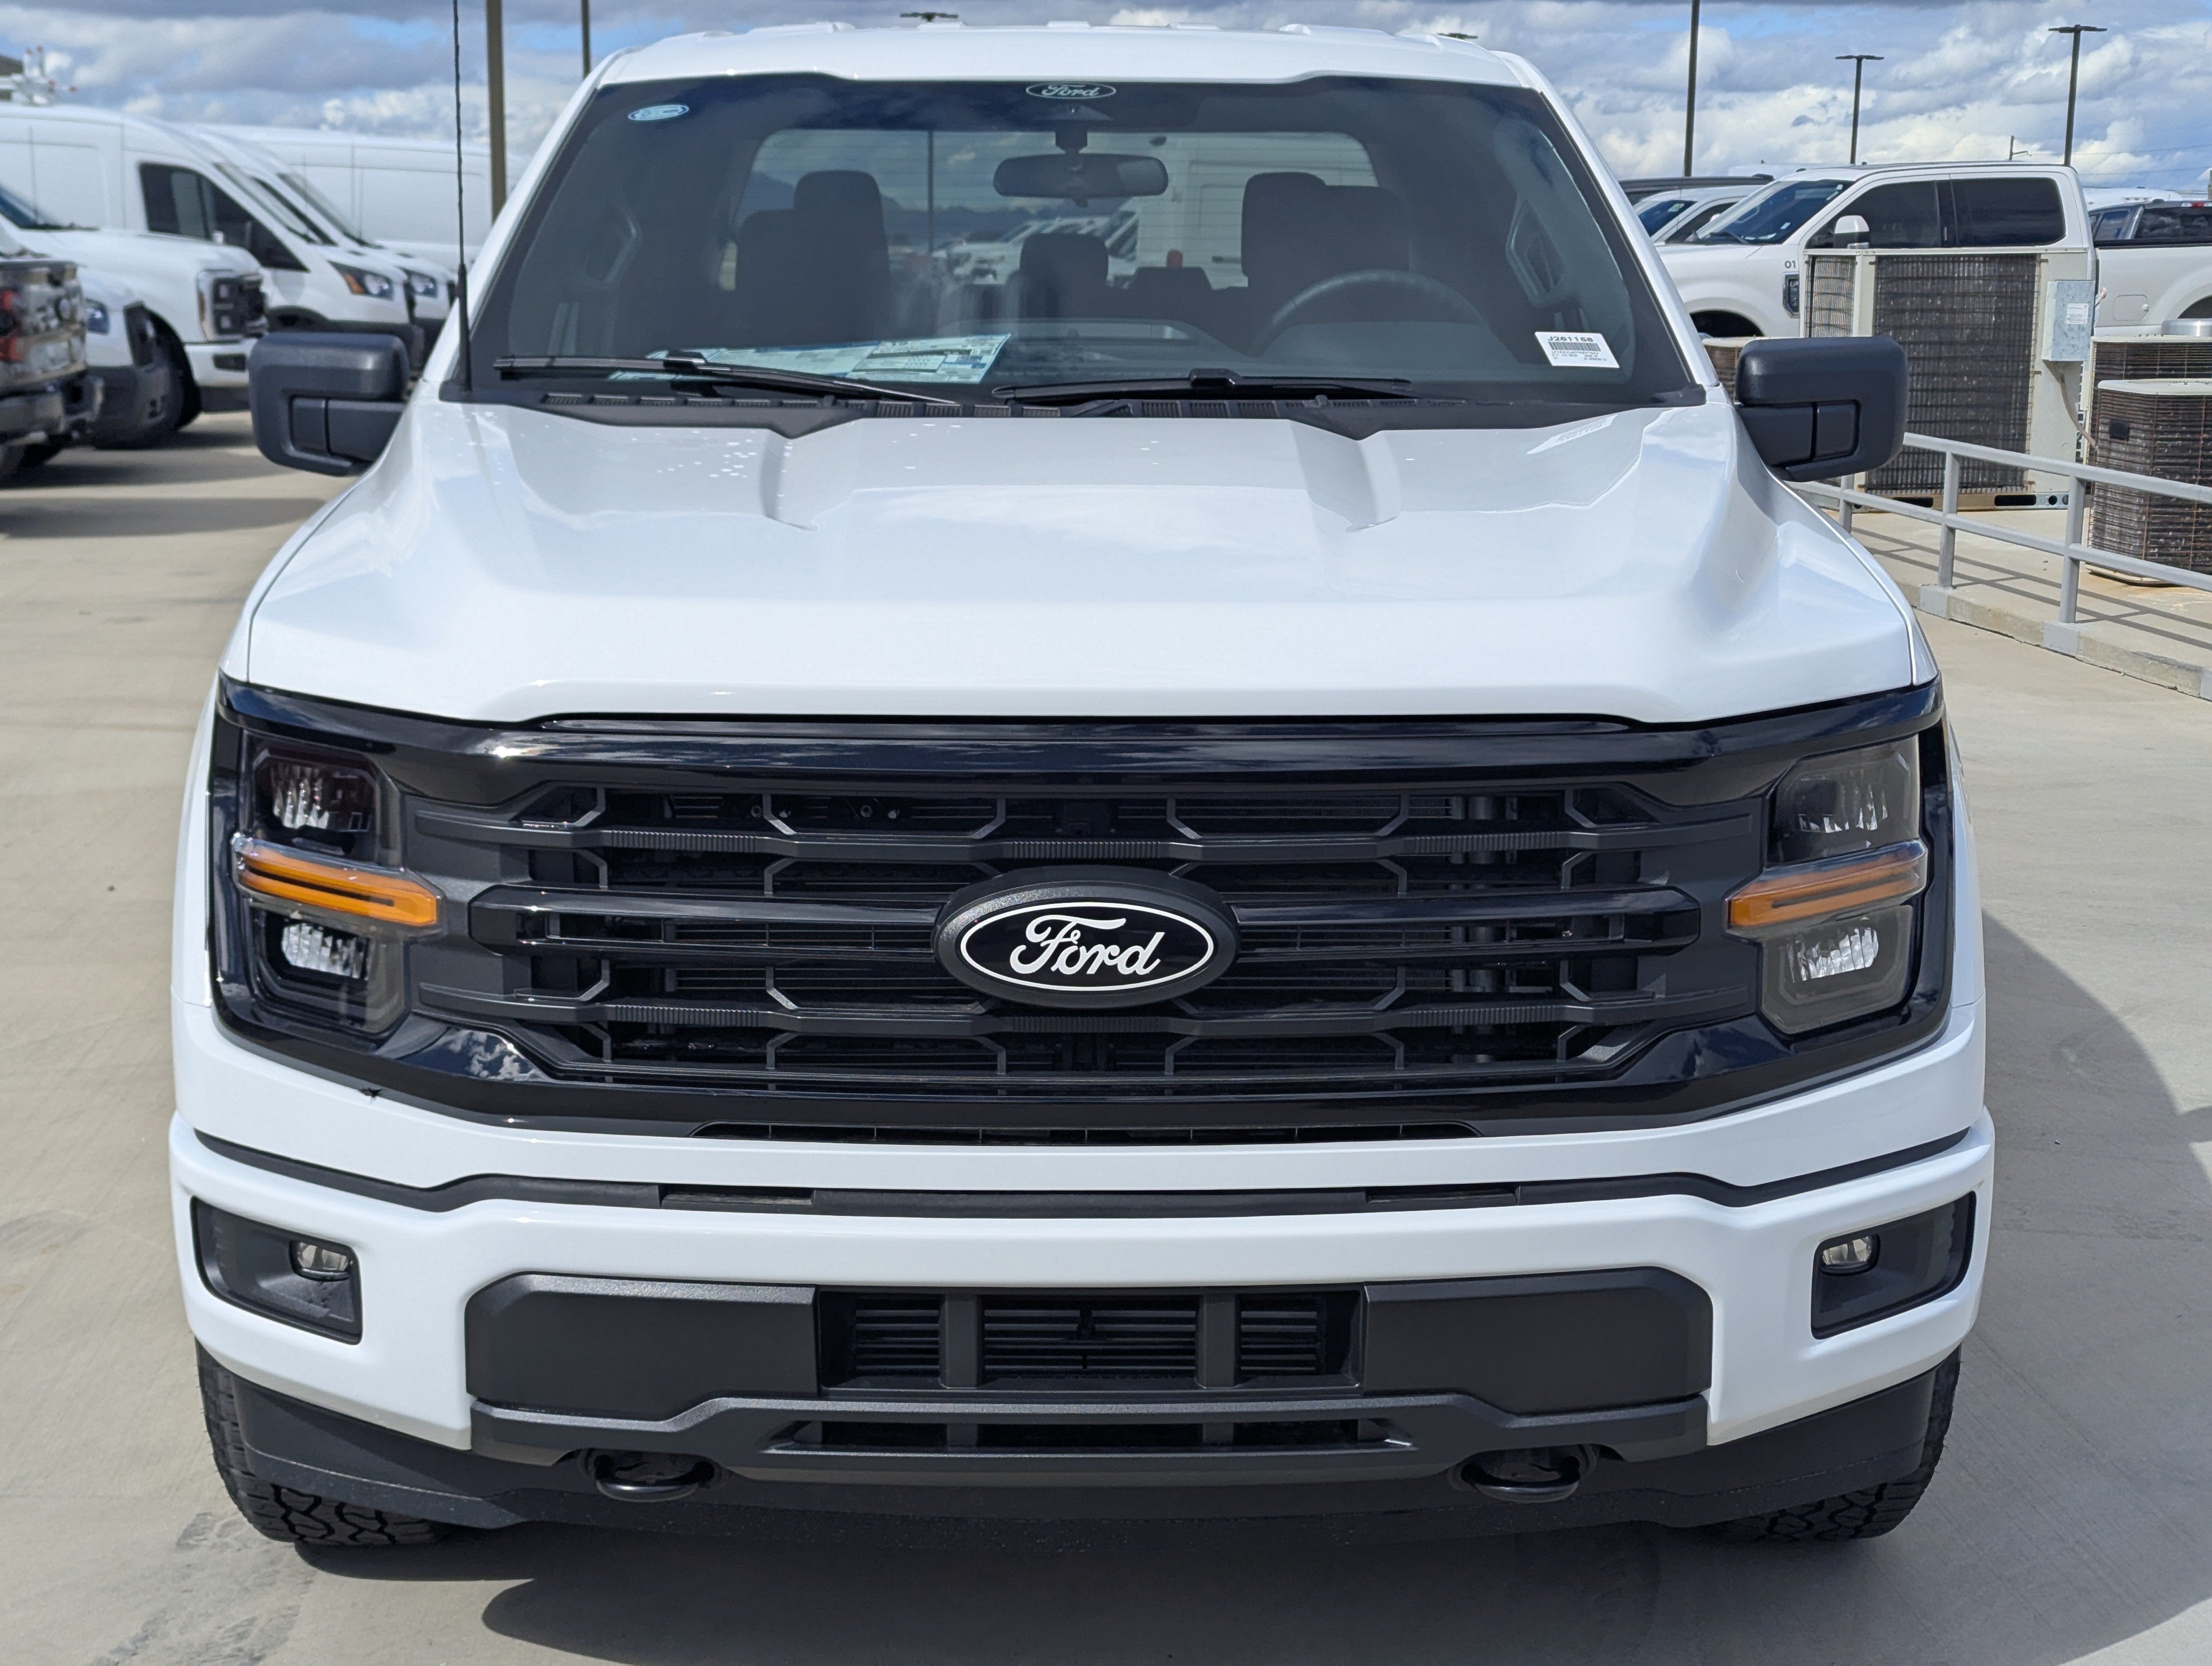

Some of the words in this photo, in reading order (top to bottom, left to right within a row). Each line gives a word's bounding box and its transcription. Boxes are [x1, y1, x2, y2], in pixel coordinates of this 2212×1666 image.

[1041, 85, 1100, 96] Ford
[1785, 260, 1796, 268] 01
[1009, 915, 1165, 975] Ford
